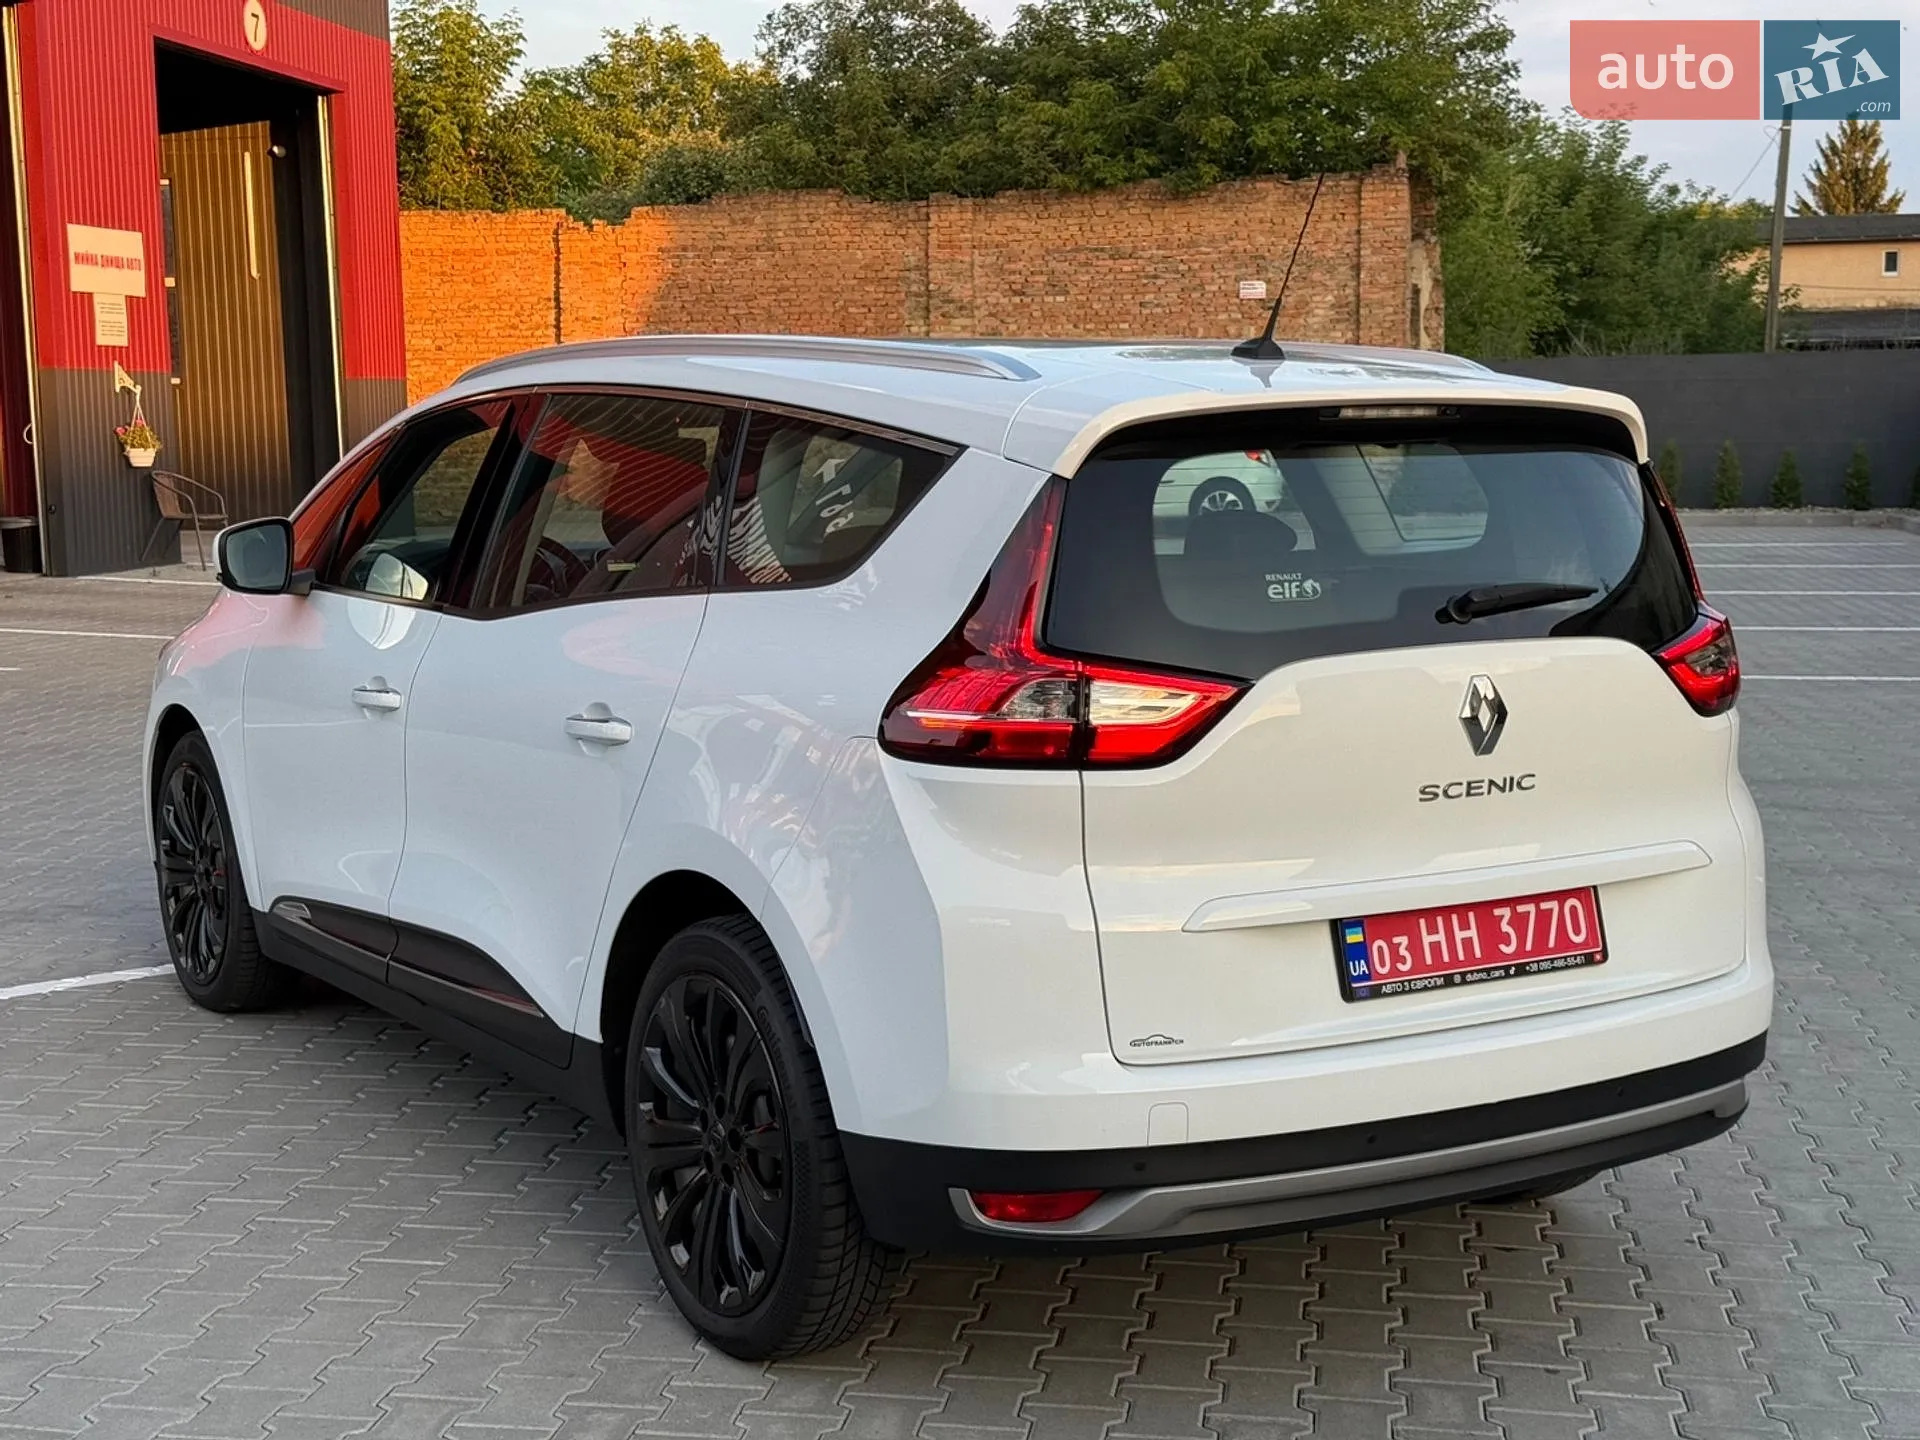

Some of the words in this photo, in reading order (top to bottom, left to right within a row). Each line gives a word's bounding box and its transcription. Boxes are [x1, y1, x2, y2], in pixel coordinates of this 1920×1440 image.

[251, 12, 260, 42] 7
[1264, 573, 1302, 581] RENAULT
[1267, 582, 1300, 599] elf
[1418, 774, 1536, 802] SCENIC
[1371, 935, 1413, 975] 03
[1418, 911, 1482, 965] HH
[1493, 897, 1588, 955] 3770
[1350, 960, 1369, 977] UA
[1381, 982, 1403, 994] АВТО
